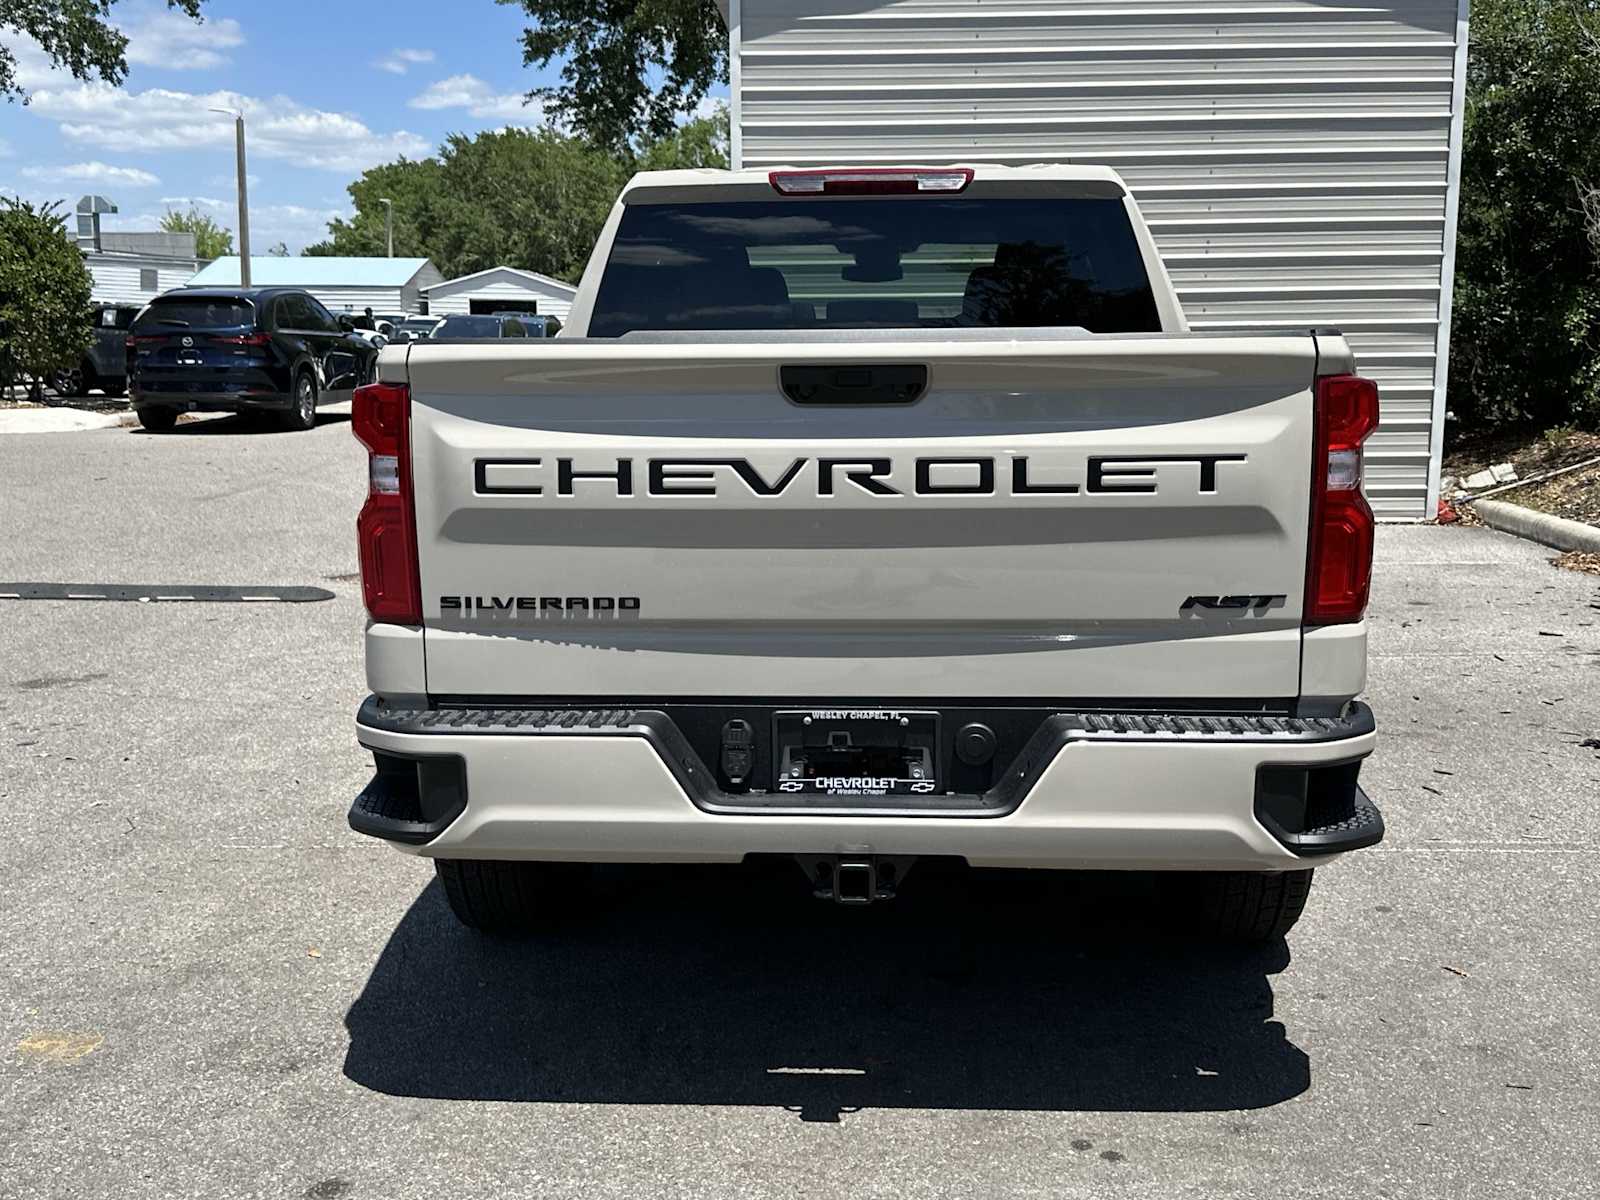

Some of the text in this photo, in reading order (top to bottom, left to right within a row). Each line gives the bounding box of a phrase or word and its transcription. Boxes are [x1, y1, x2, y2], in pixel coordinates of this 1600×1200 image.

[474, 454, 1248, 498] CHEVROLET
[439, 595, 641, 610] SILVERADO
[1179, 594, 1288, 609] RST
[812, 711, 901, 721] WESLEY CHAPEL, FL
[815, 777, 898, 789] CHEVROLET
[837, 788, 861, 796] Wesley
[862, 788, 887, 796] Chapel
